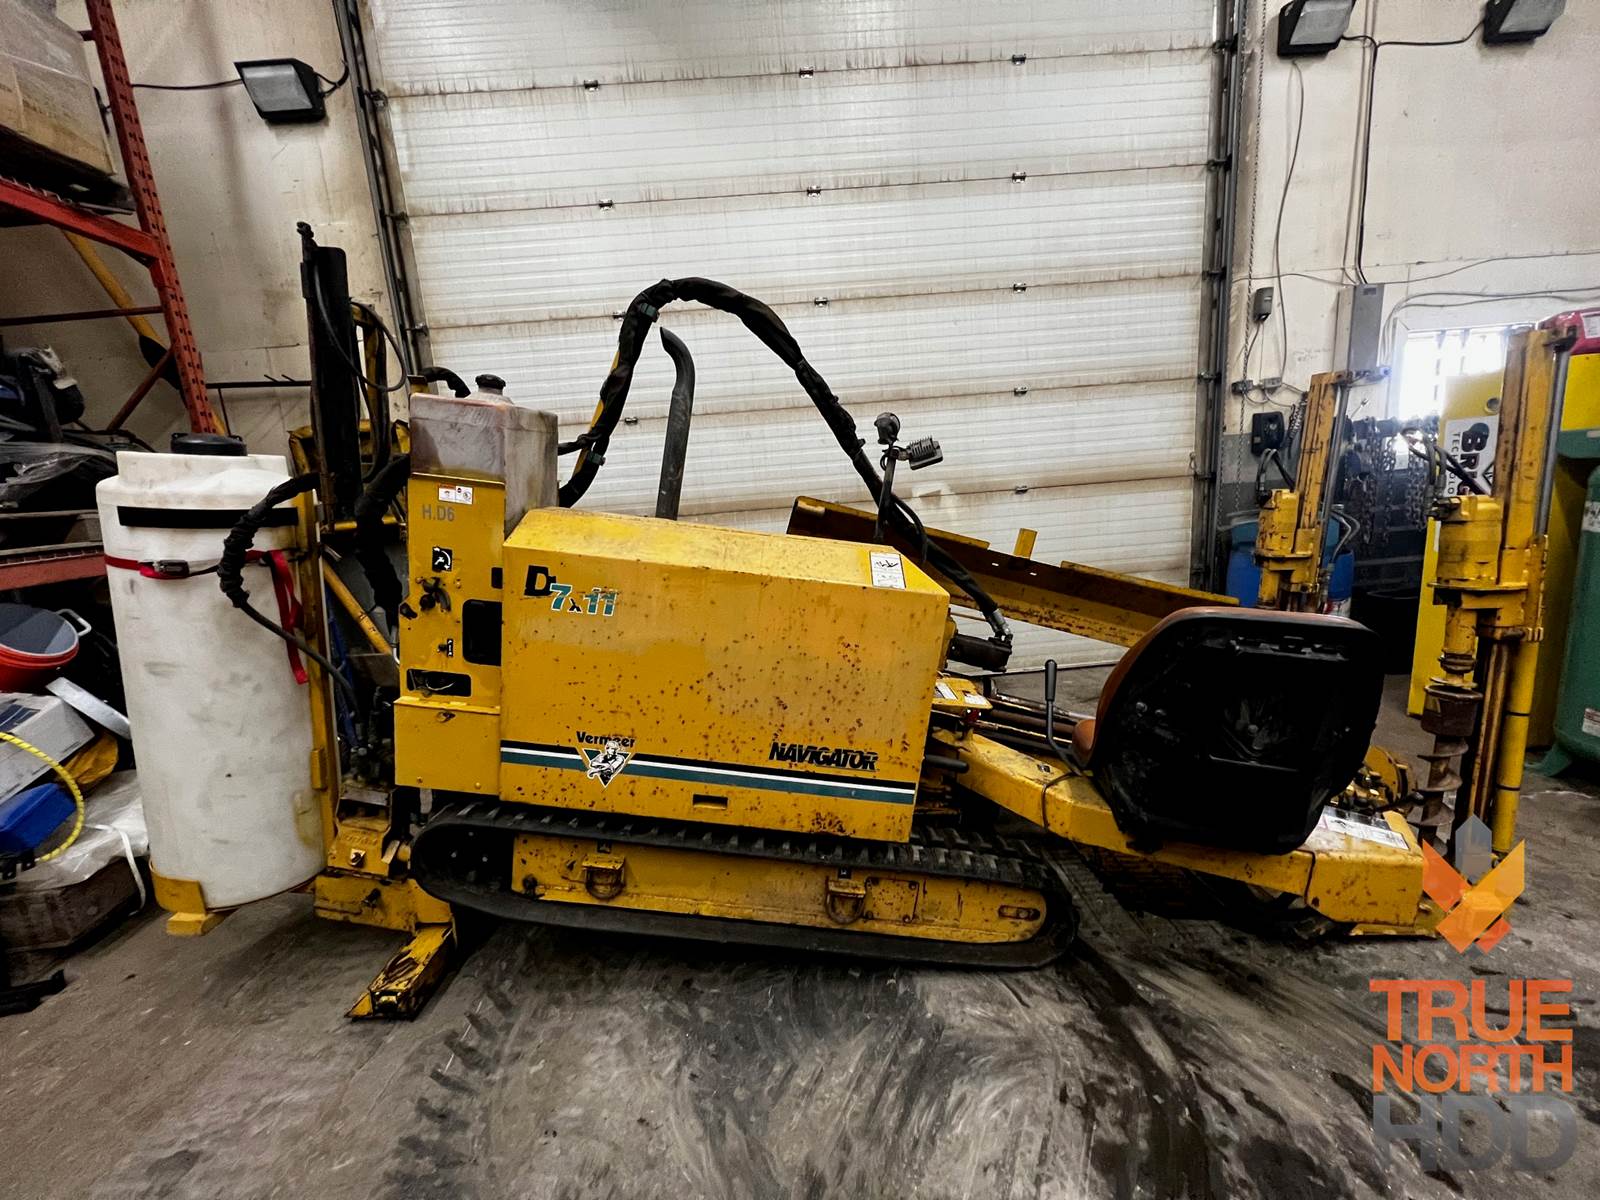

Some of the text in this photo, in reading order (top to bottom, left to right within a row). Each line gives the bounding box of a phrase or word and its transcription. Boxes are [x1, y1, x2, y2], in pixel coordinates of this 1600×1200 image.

[422, 504, 455, 521] H.D6
[576, 731, 635, 748] Vermeer
[769, 742, 878, 770] NAVIGATOR
